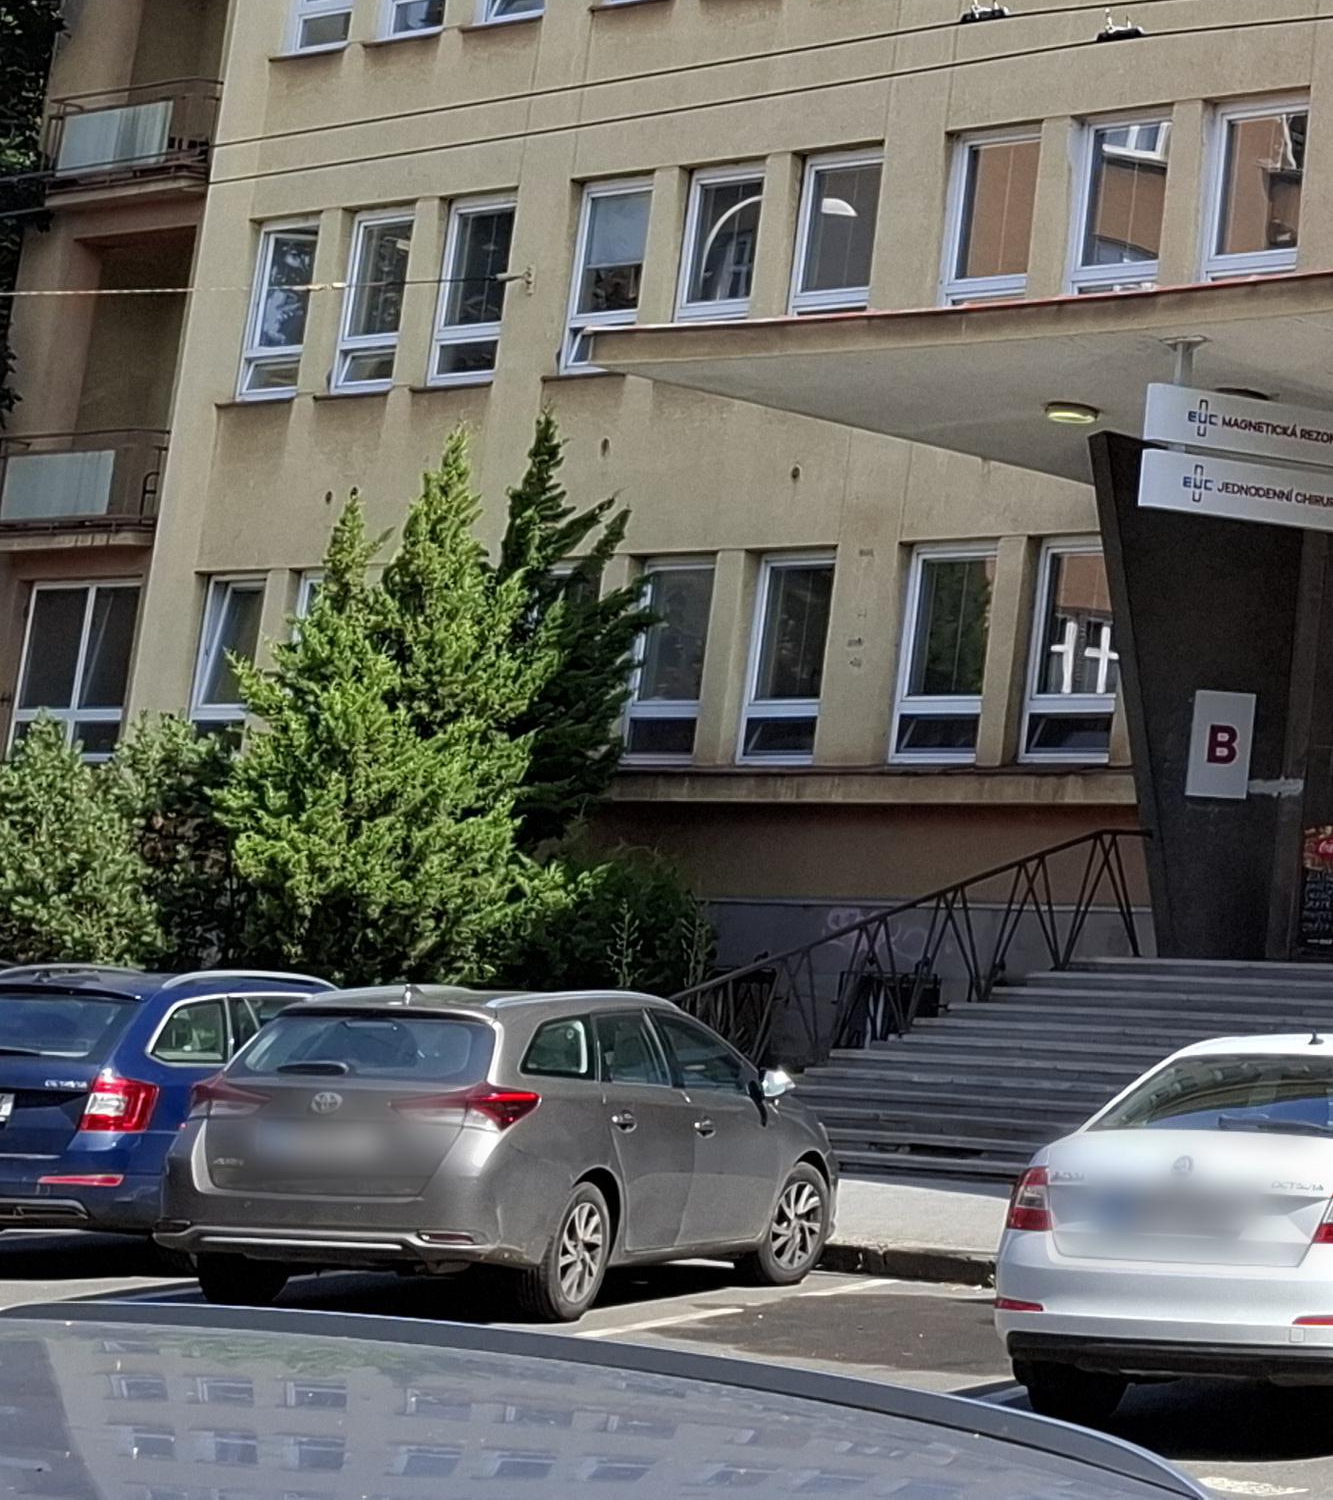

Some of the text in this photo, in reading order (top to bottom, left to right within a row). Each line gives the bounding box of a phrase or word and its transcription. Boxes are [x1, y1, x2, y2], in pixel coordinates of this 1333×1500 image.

[1222, 416, 1298, 438] MAGNETICKÁ
[1217, 482, 1293, 501] JEDNODENNÍ
[1206, 723, 1239, 765] B
